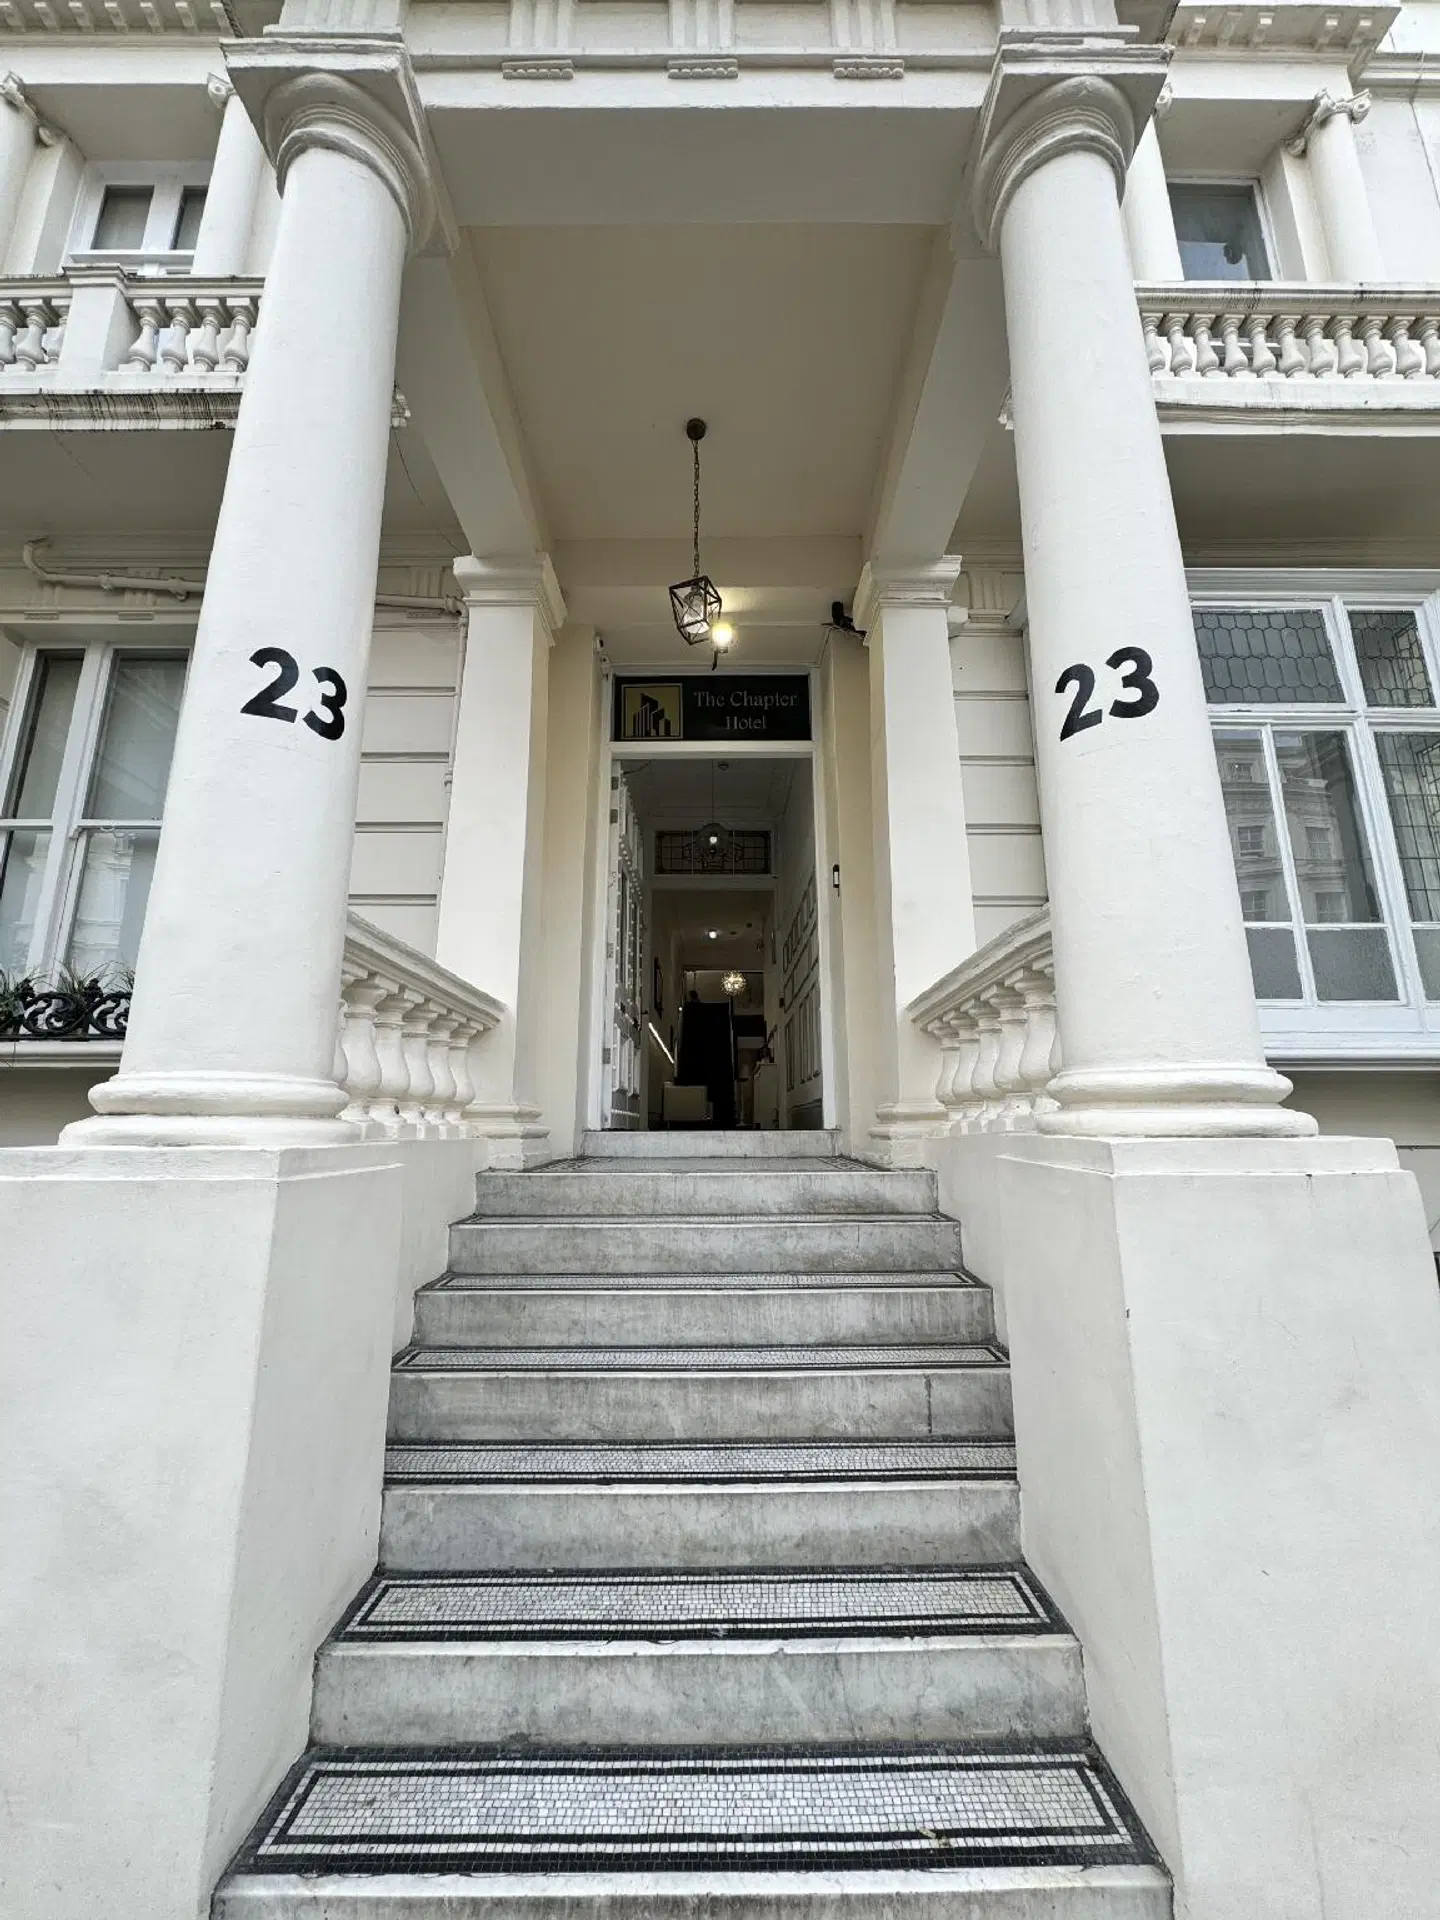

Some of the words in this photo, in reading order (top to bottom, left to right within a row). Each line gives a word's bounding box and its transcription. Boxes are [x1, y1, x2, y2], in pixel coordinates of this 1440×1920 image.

[240, 646, 348, 741] 23
[694, 691, 725, 708] The
[729, 690, 798, 710] Chapter
[1054, 646, 1160, 742] 23
[725, 716, 767, 731] Hotel
